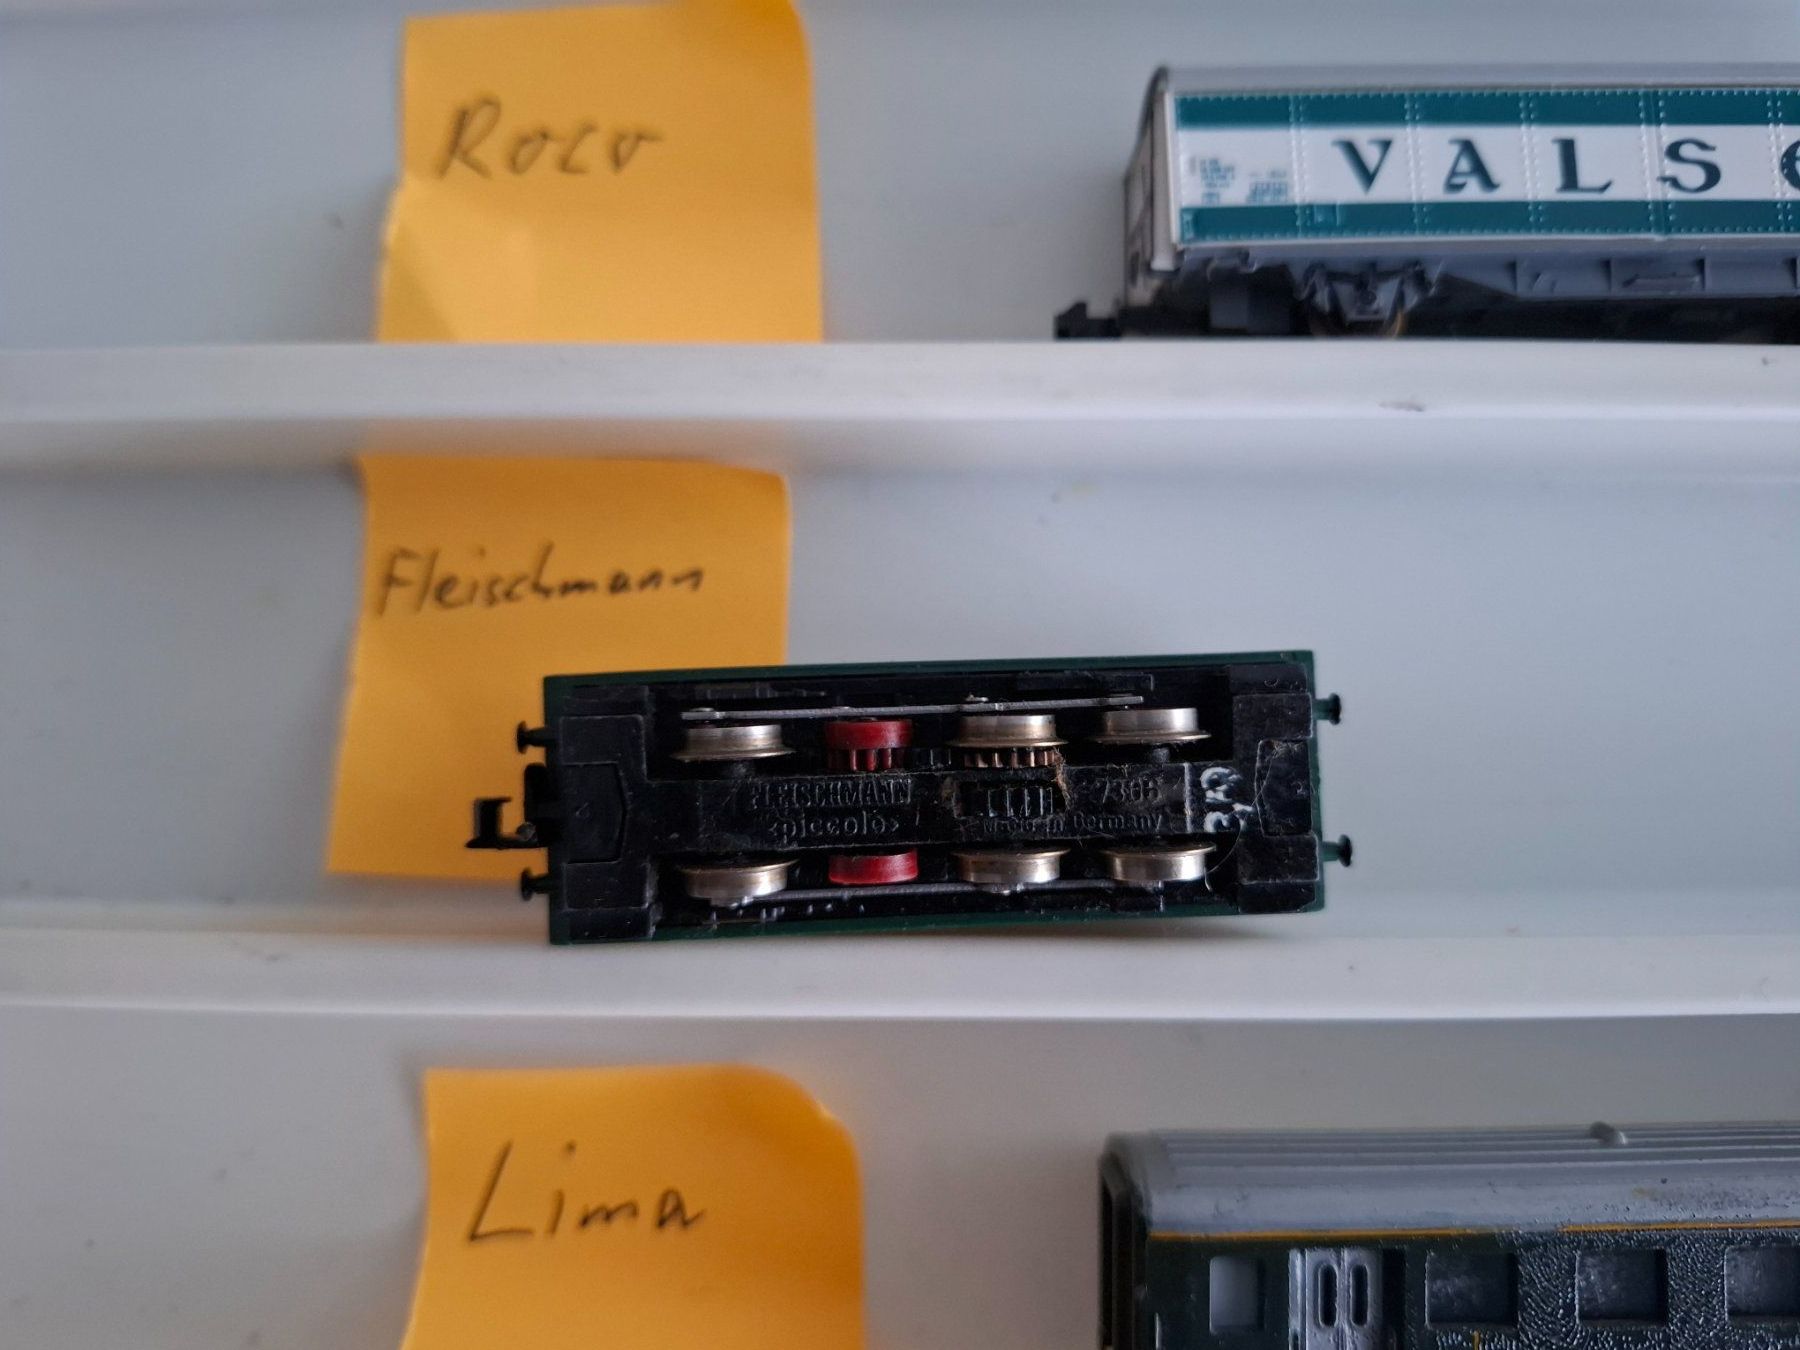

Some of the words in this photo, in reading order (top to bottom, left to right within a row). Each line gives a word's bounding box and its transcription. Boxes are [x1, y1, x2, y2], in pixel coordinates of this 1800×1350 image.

[434, 92, 664, 181] Roco
[377, 541, 705, 617] Fleischmann
[468, 1139, 706, 1243] Lima
